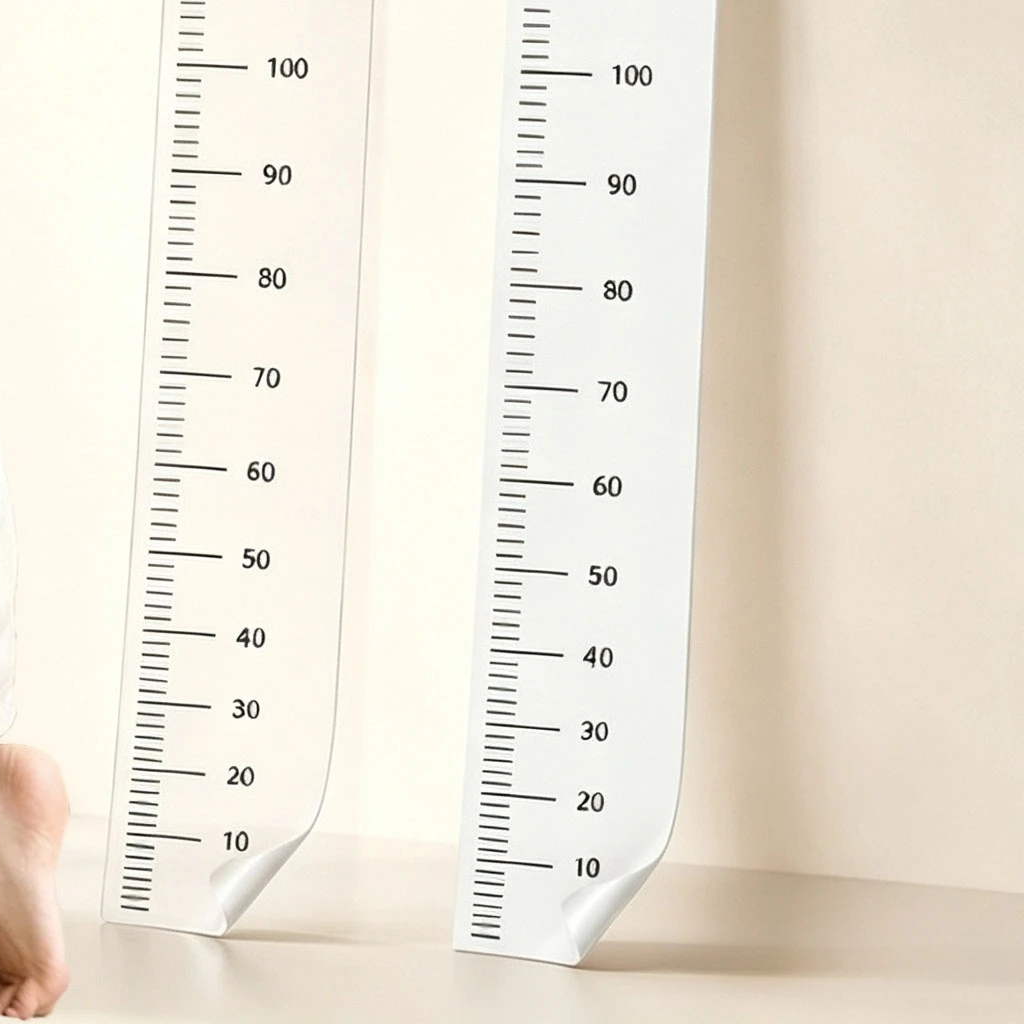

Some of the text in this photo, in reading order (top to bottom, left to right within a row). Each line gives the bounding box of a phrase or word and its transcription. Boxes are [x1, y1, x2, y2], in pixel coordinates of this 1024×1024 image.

[267, 57, 309, 80] 100
[612, 64, 653, 87] 100
[262, 163, 292, 186] 90
[607, 173, 637, 196] 90
[258, 267, 287, 290] 80
[603, 279, 633, 302] 80
[253, 366, 281, 389] 70
[597, 380, 628, 403] 70
[246, 460, 276, 483] 60
[592, 475, 623, 498] 60
[241, 548, 271, 570] 50
[588, 564, 618, 587] 50
[235, 627, 266, 649] 40
[582, 645, 614, 669] 40
[232, 698, 260, 720] 30
[580, 720, 609, 742] 30
[226, 765, 255, 787] 20
[576, 790, 605, 813] 20
[223, 830, 249, 852] 10
[575, 857, 601, 879] 10
